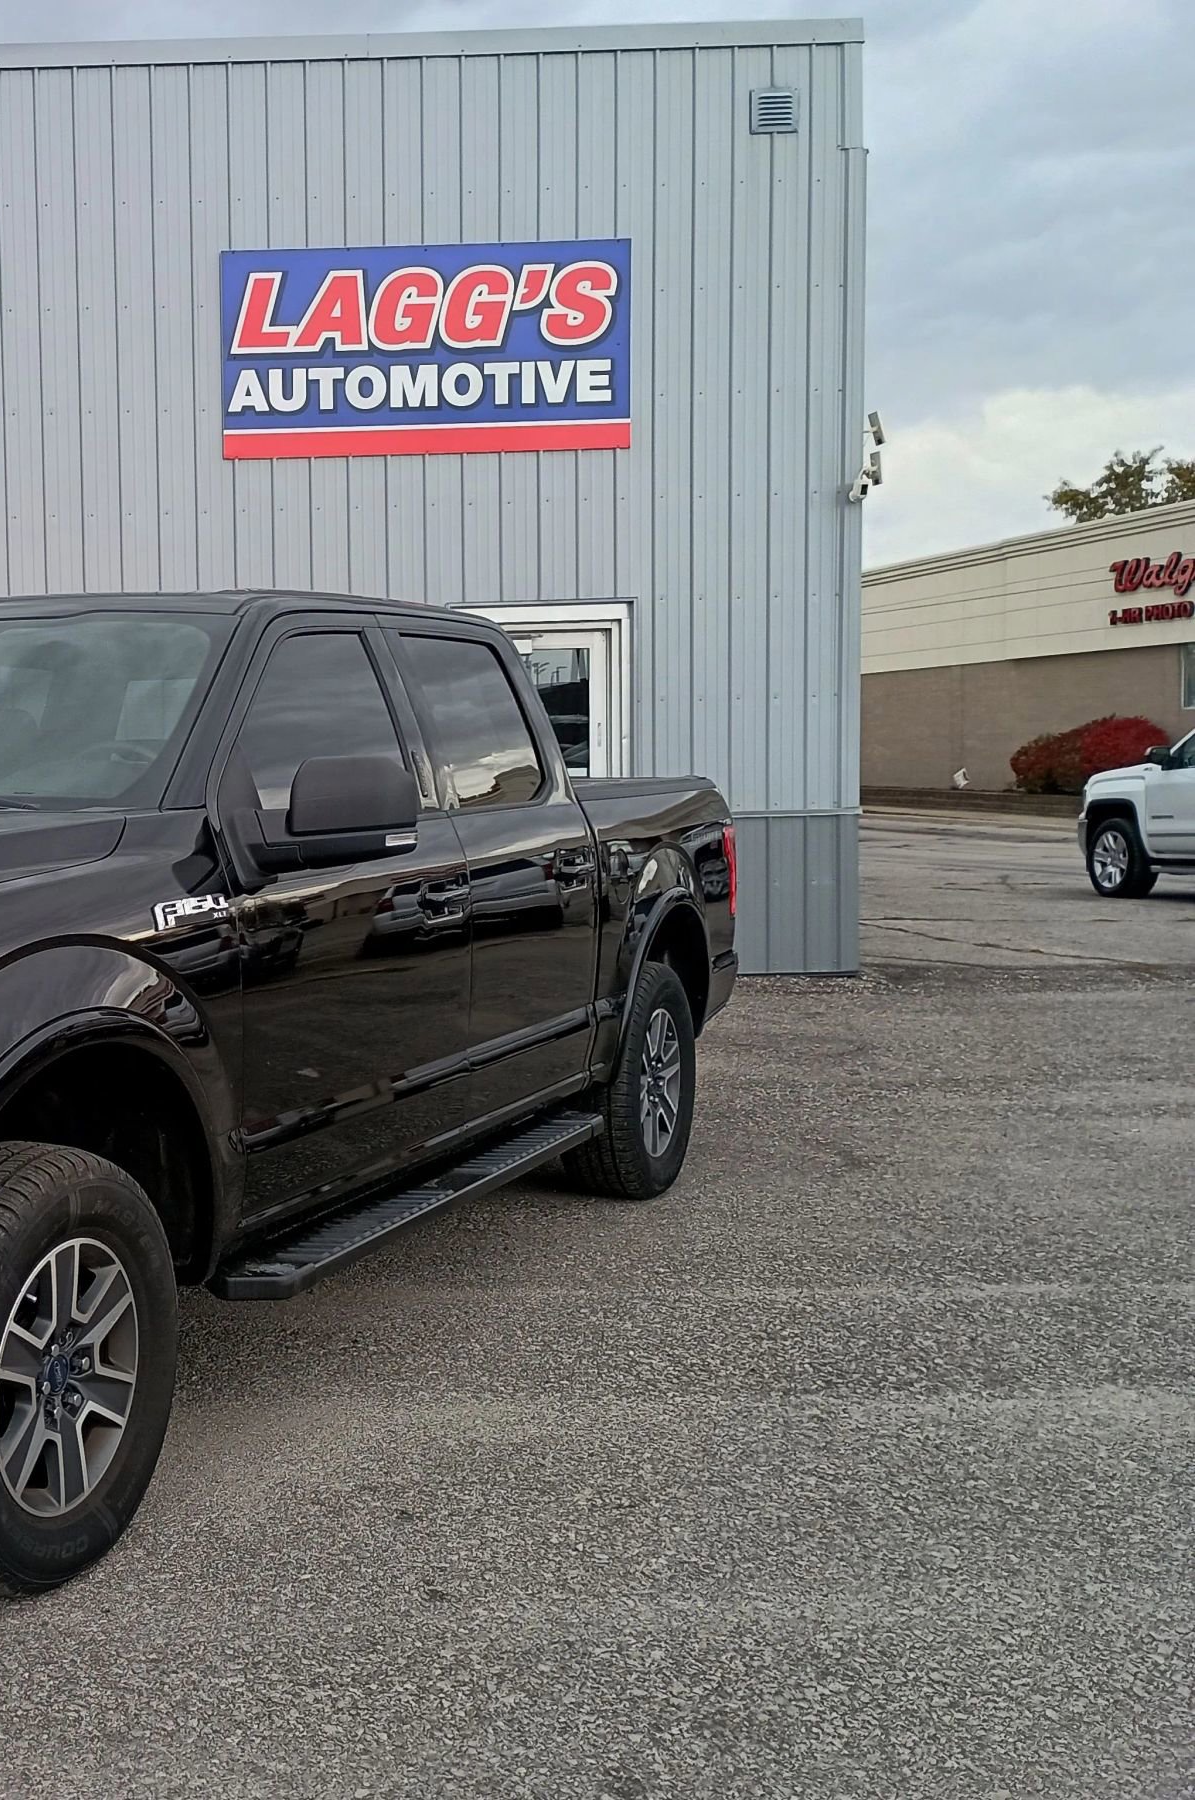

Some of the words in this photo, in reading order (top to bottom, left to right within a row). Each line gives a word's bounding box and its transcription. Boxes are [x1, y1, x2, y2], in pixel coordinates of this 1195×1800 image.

[231, 261, 617, 354] LAGG'S
[228, 359, 612, 412] AUTOMOTIVE
[1109, 551, 1195, 596] Walg
[1108, 607, 1143, 625] 1-HR
[1145, 601, 1194, 621] PHOTO
[212, 910, 228, 919] XLT
